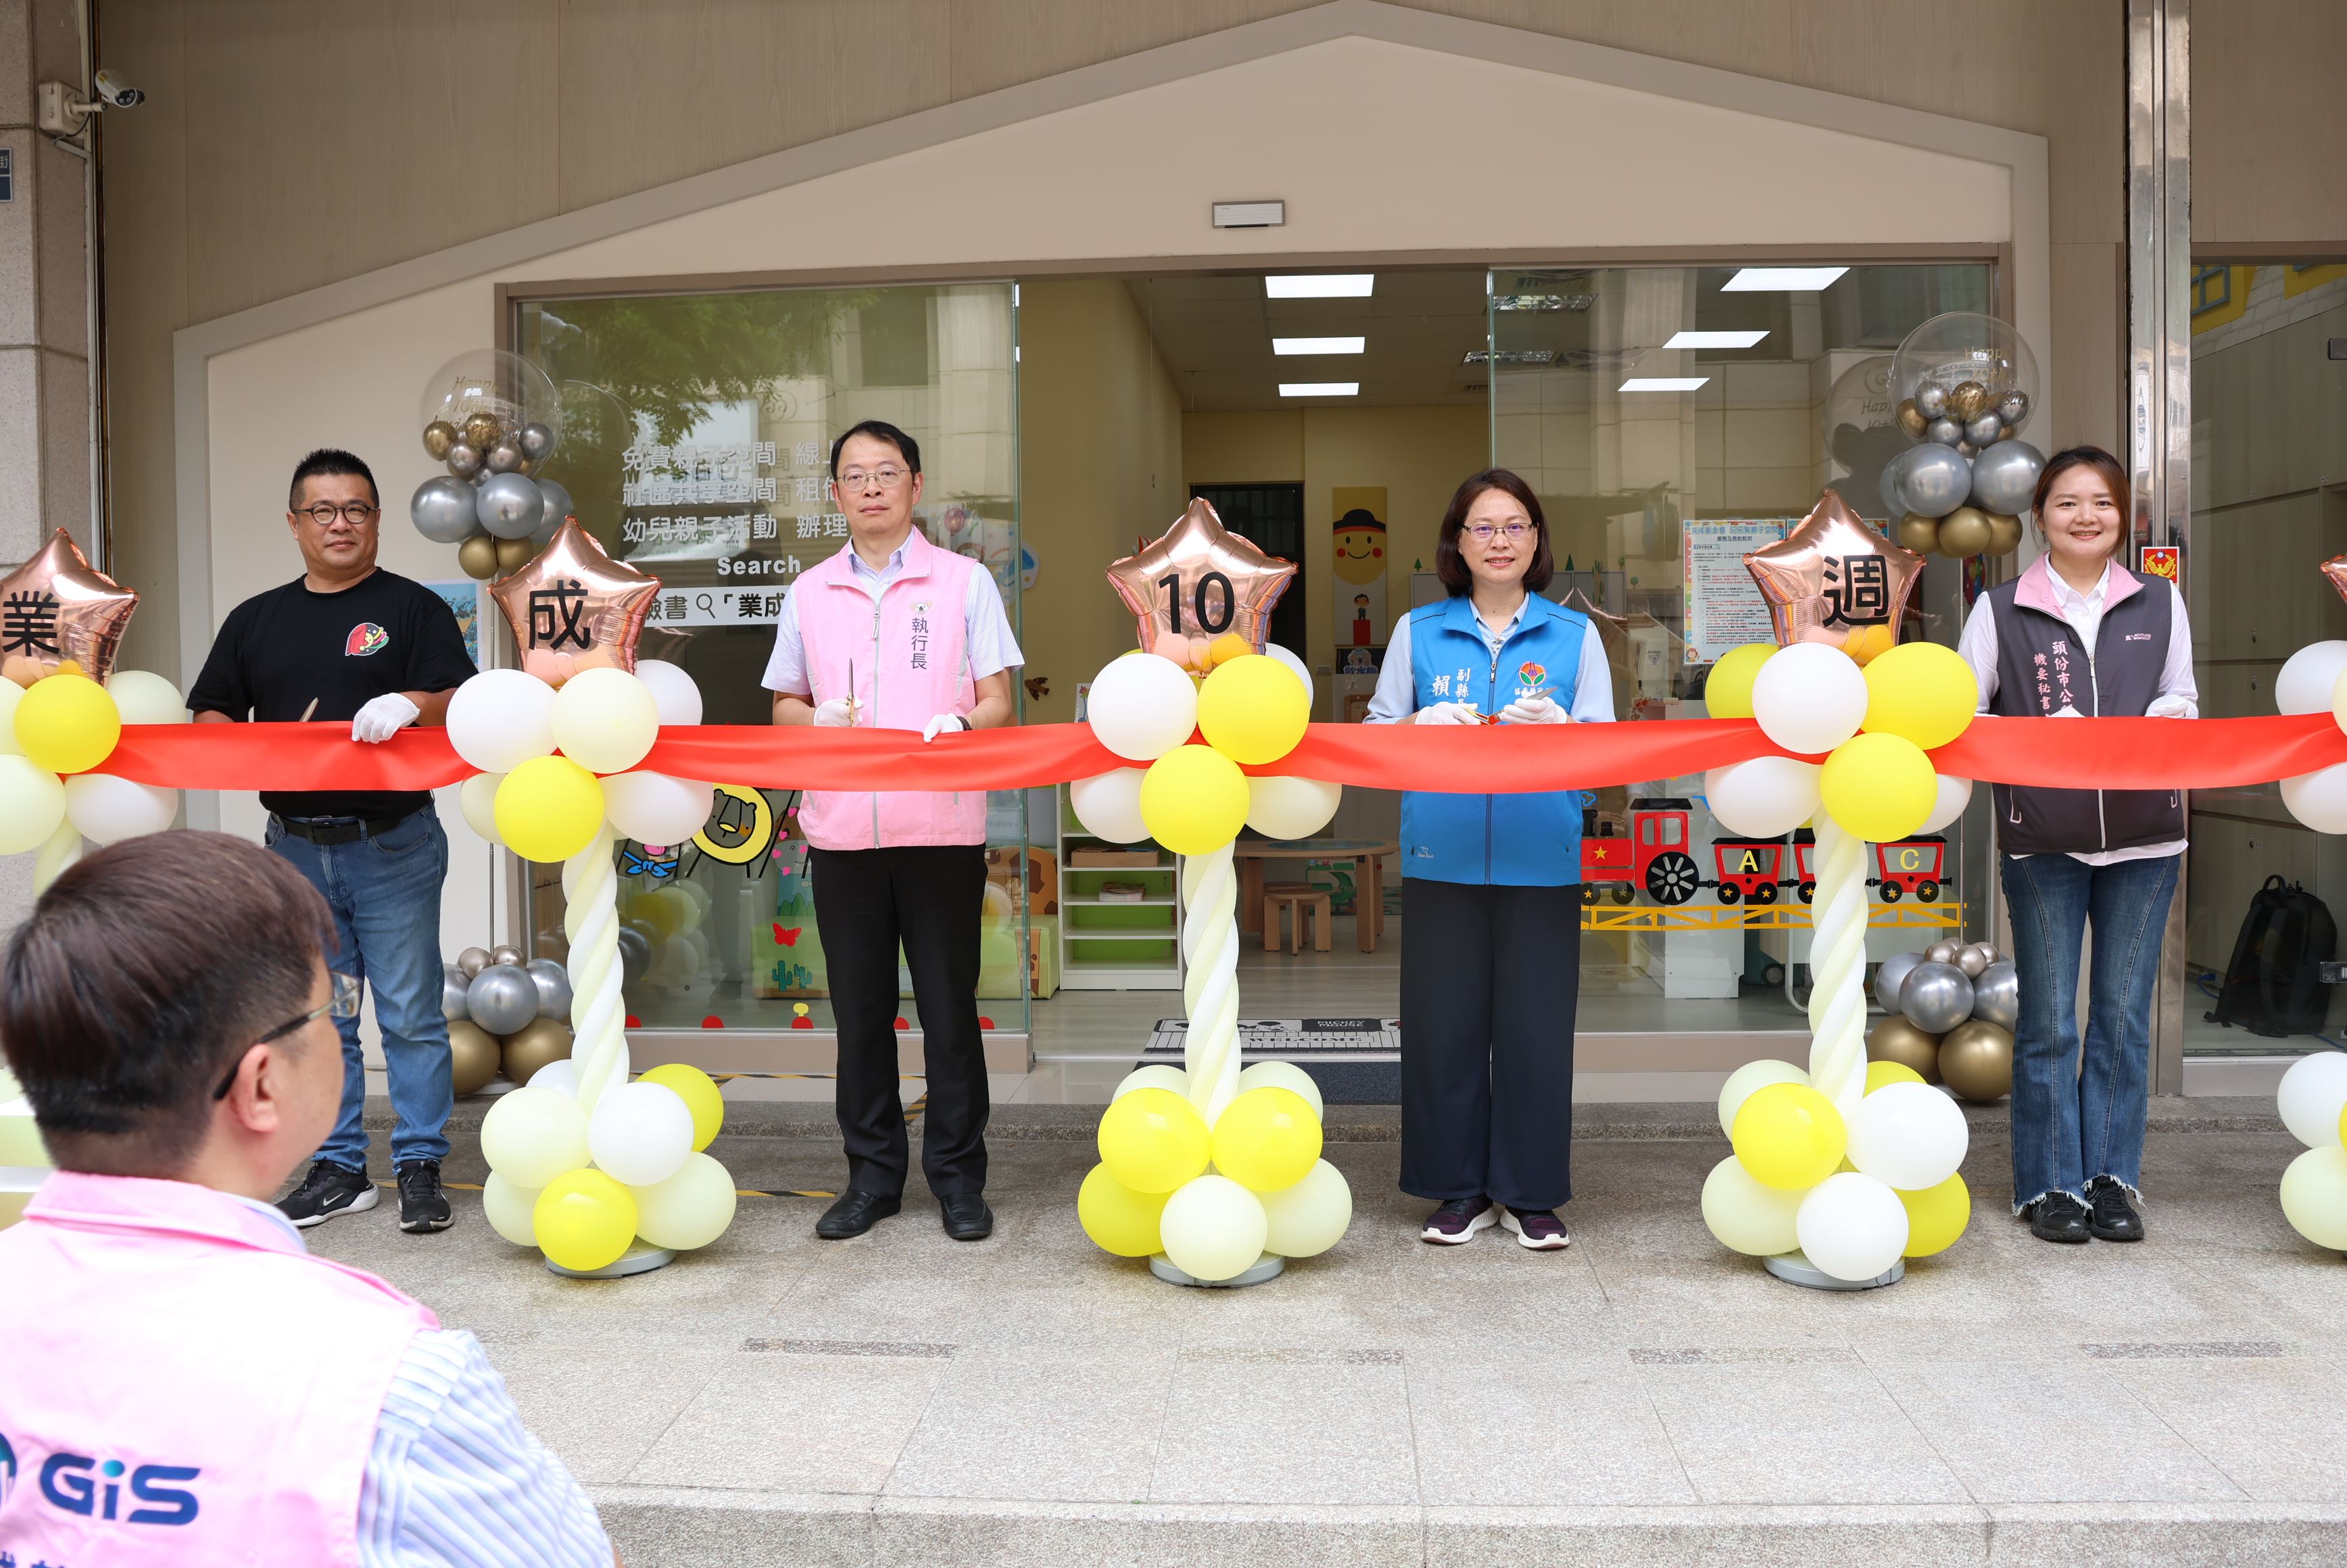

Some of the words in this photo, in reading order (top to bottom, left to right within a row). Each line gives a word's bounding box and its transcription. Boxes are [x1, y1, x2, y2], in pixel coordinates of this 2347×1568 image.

[1965, 346, 2010, 362] Happy
[453, 376, 499, 393] Happy
[622, 441, 777, 472] 免費親子空間
[623, 477, 777, 507] 社區共享空間
[623, 513, 777, 543] 幼兒親子活動
[796, 513, 848, 539] 辦理
[717, 554, 800, 575] Search
[1158, 572, 1234, 634] 10
[1822, 554, 1890, 626] 週
[2, 591, 59, 657] 業
[529, 579, 591, 650] 成
[911, 617, 929, 670] 執行長
[1432, 675, 1451, 697] 賴
[2034, 653, 2051, 716] 機要秘書
[1738, 850, 1759, 872] A
[1900, 849, 1919, 871] C
